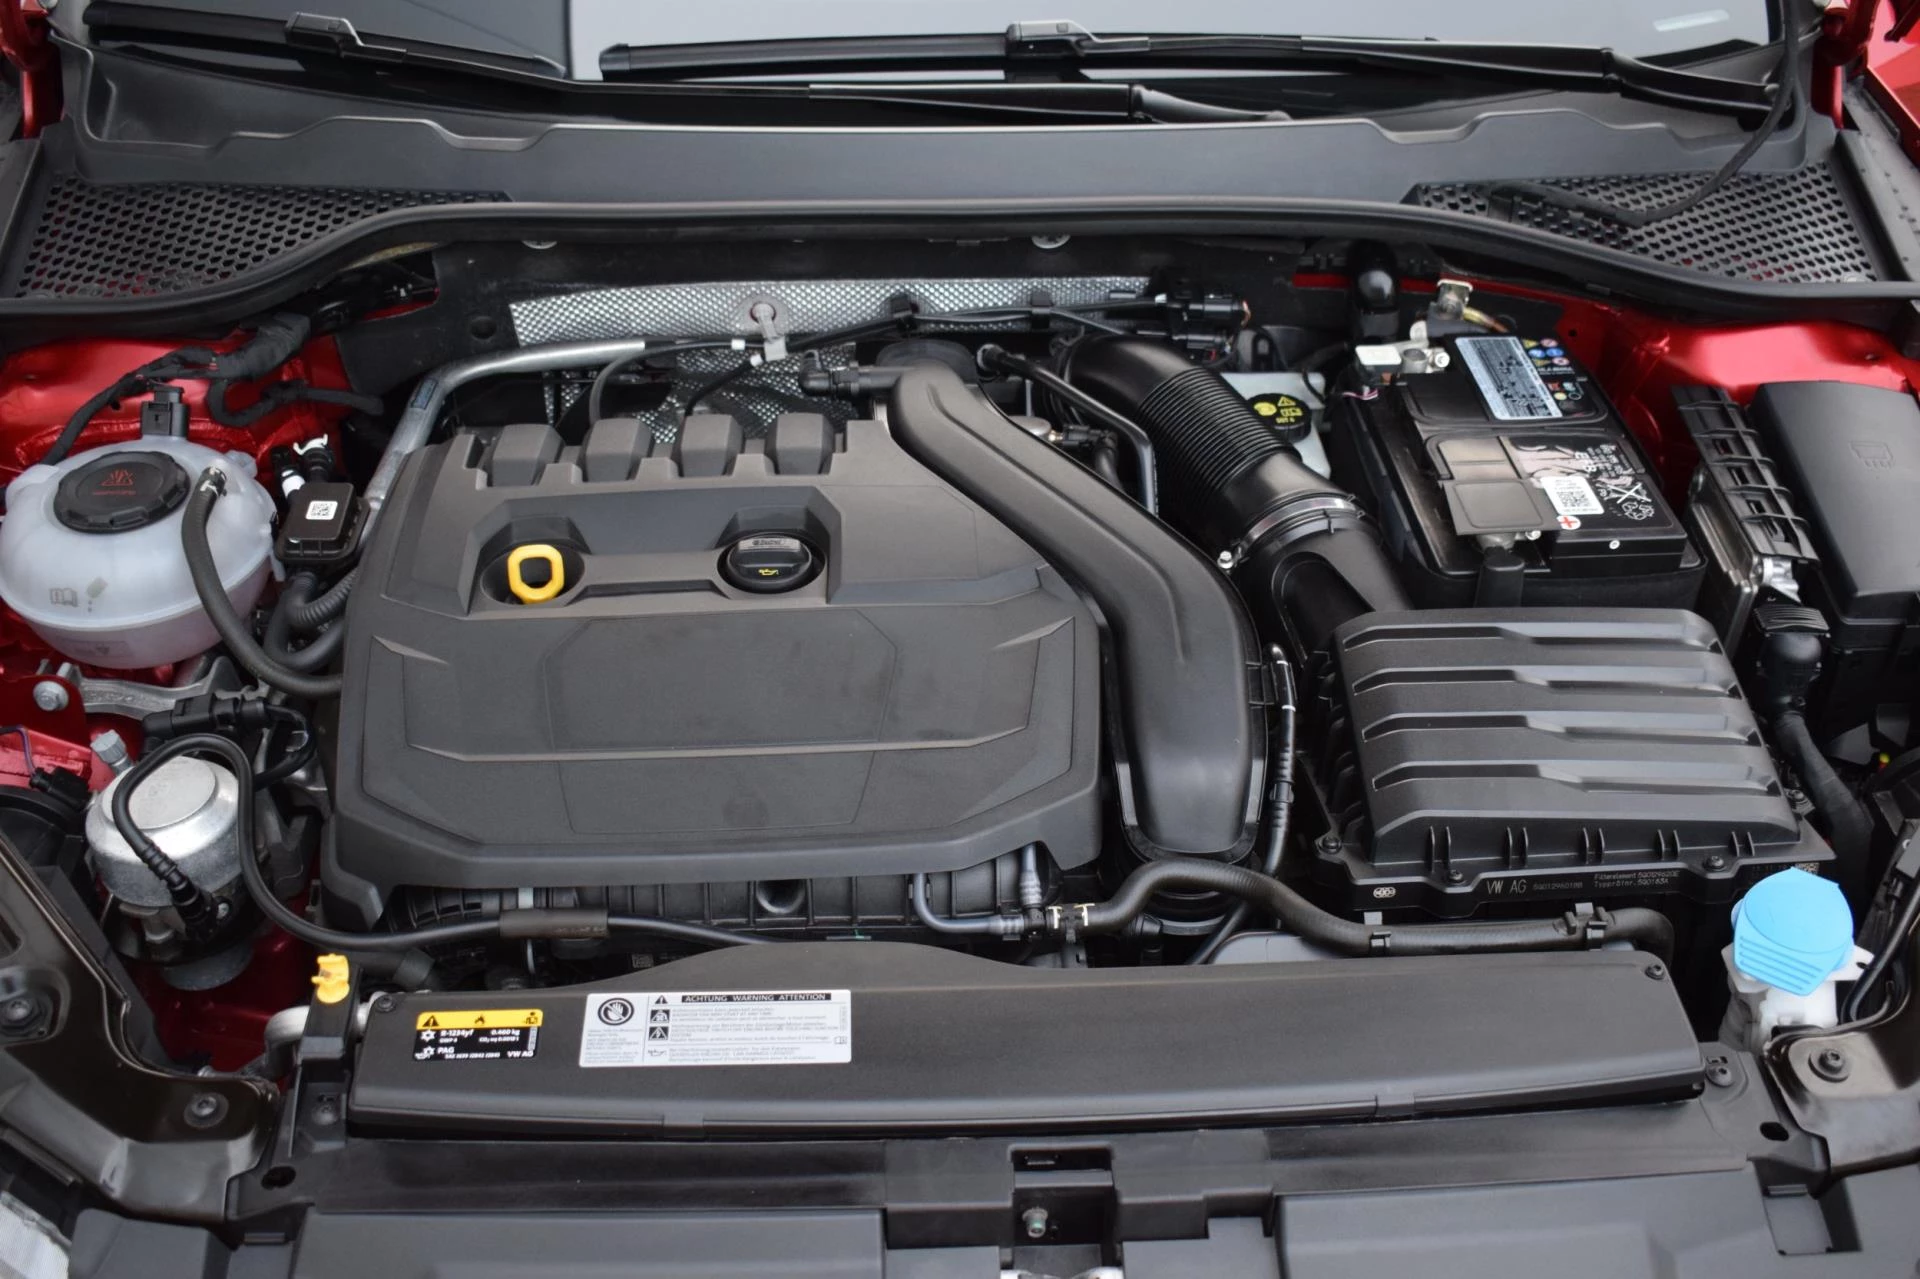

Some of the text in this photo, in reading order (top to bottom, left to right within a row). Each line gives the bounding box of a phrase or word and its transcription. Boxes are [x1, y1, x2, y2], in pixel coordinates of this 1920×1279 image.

[1486, 879, 1504, 894] VW
[1509, 878, 1527, 894] AG
[778, 993, 826, 1001] ATTENTION
[437, 1046, 455, 1054] PAG
